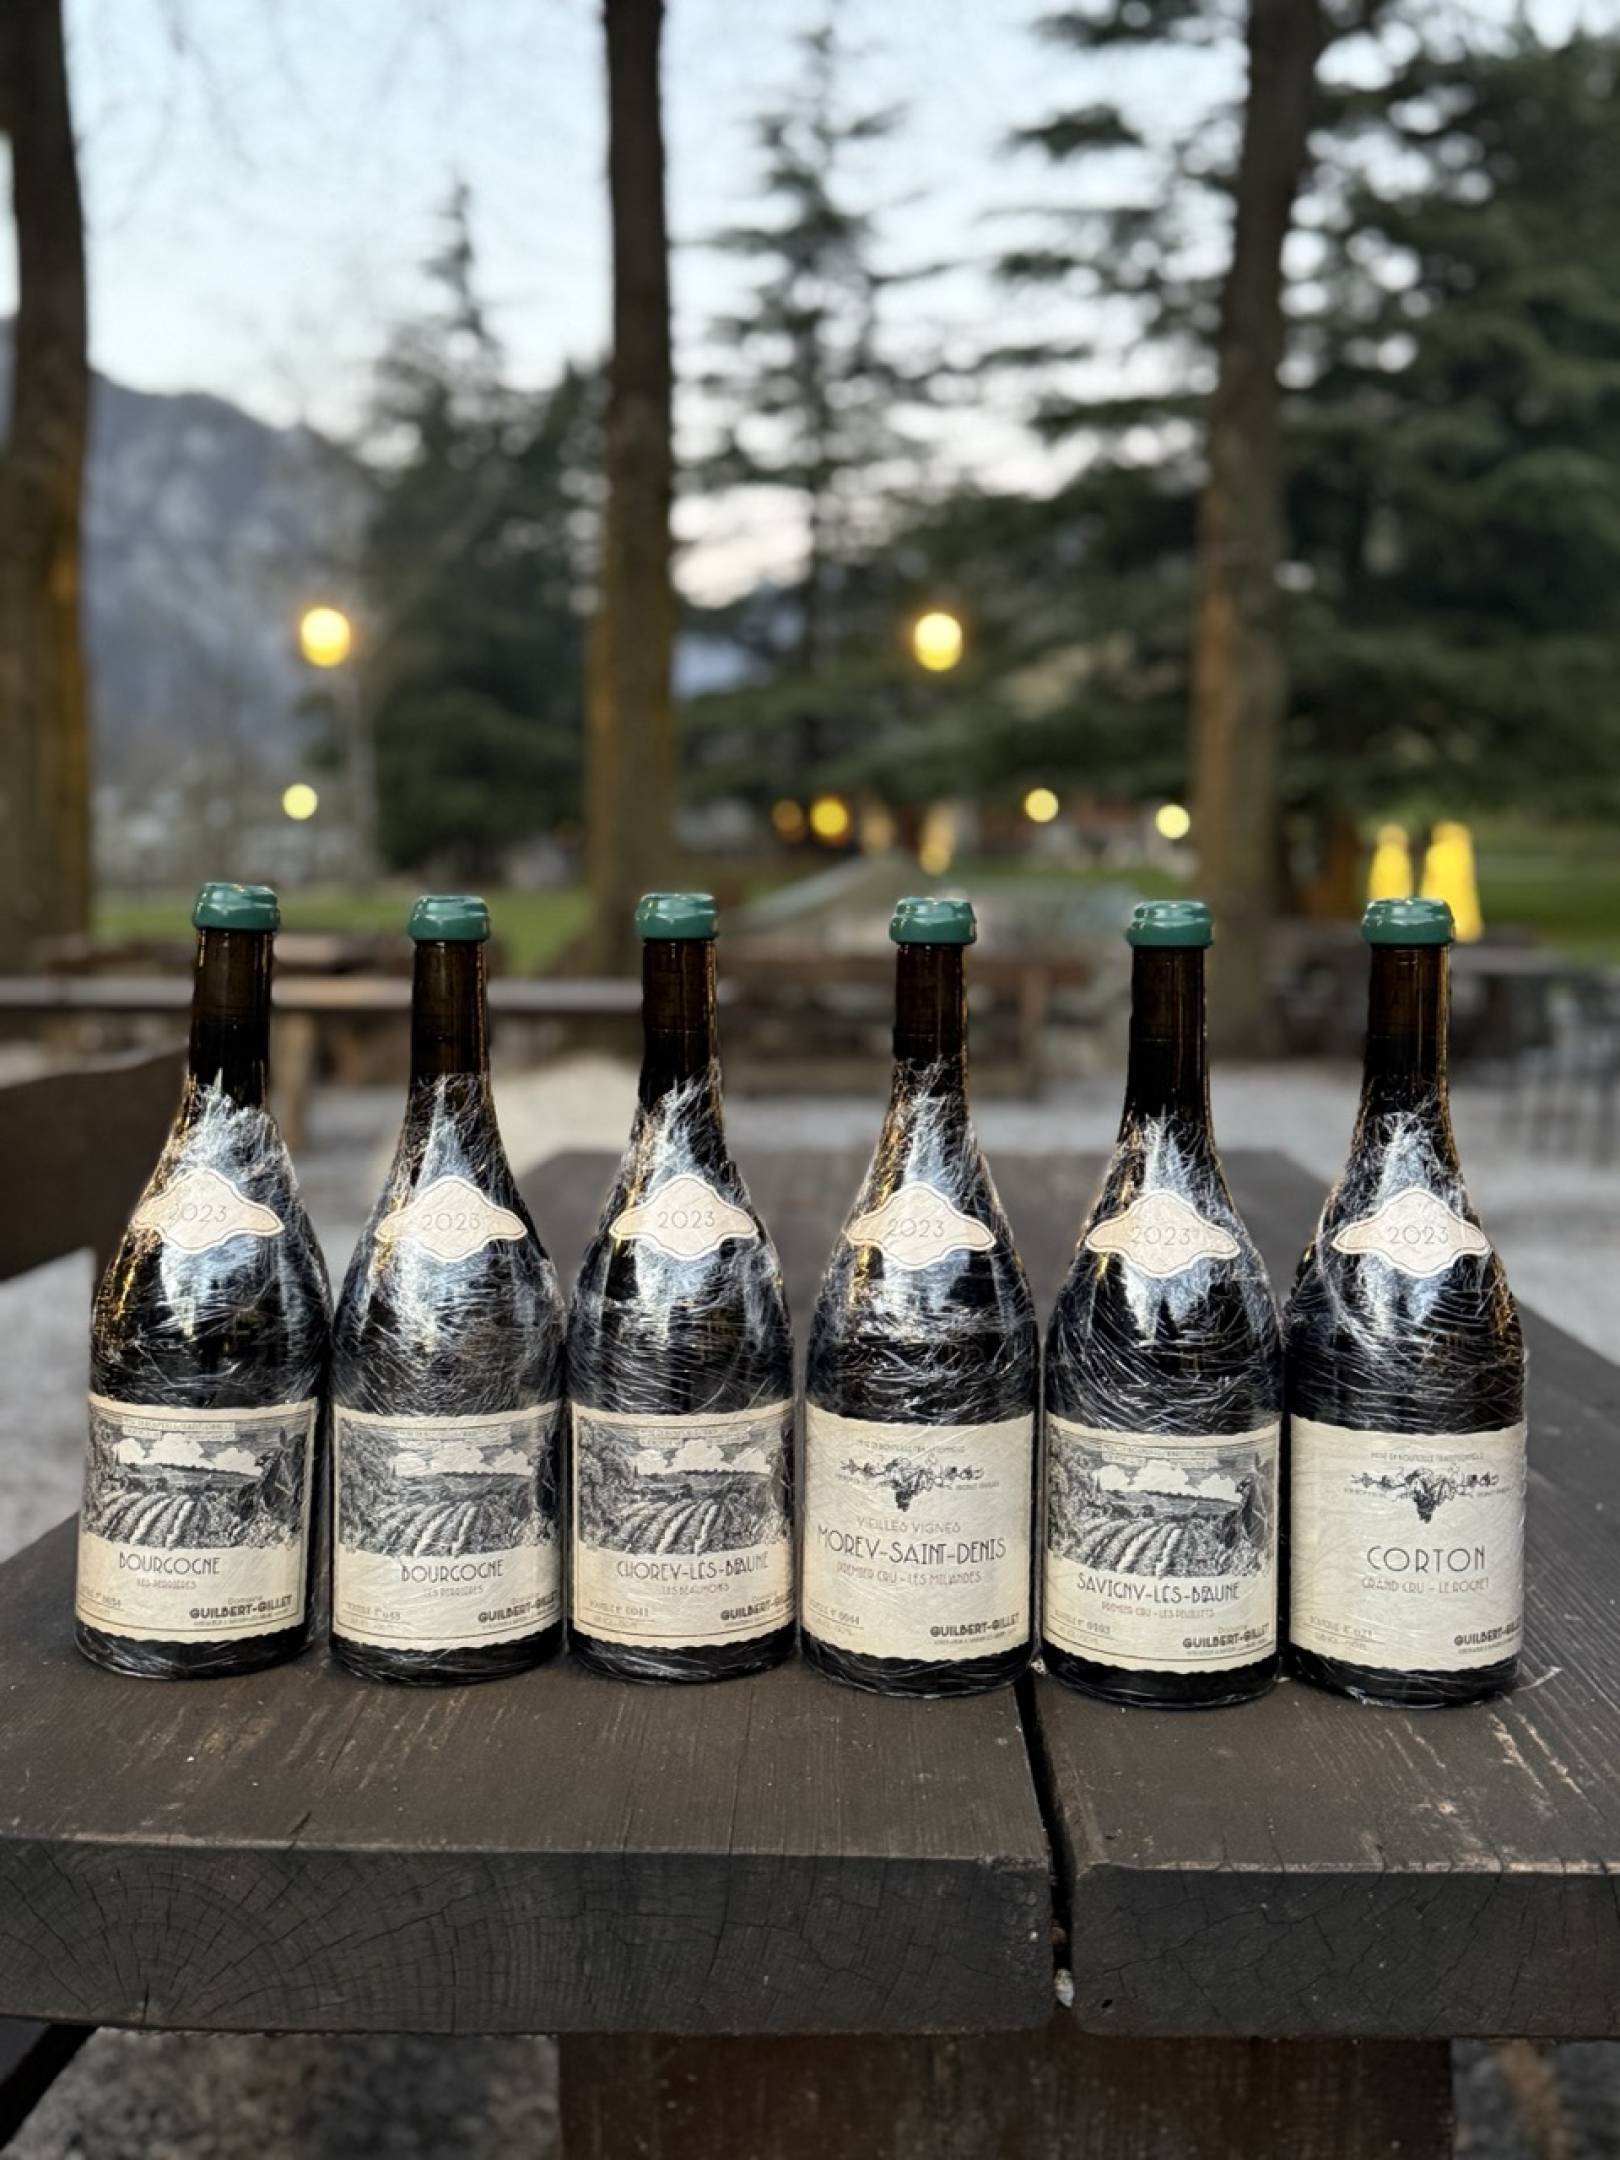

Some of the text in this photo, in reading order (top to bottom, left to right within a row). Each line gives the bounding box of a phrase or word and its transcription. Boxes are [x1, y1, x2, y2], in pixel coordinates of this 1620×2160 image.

[421, 1213, 481, 1231] 2023
[657, 1209, 715, 1229] 2023
[886, 1217, 945, 1238] 2023
[1131, 1225, 1191, 1246] 2023
[1386, 1224, 1449, 1245] 2023
[912, 1520, 961, 1534] VIGNES
[816, 1524, 1007, 1565] MOREY-SAINT-DENIS
[118, 1551, 221, 1575] BOURGOGNE
[1366, 1545, 1486, 1574] CORTON
[401, 1558, 504, 1583] BOURGOGNE
[1402, 1581, 1425, 1594] CRU
[189, 1594, 293, 1619] GUILBERT-GILLET
[930, 1612, 1020, 1638] GUILBERT-GILLET
